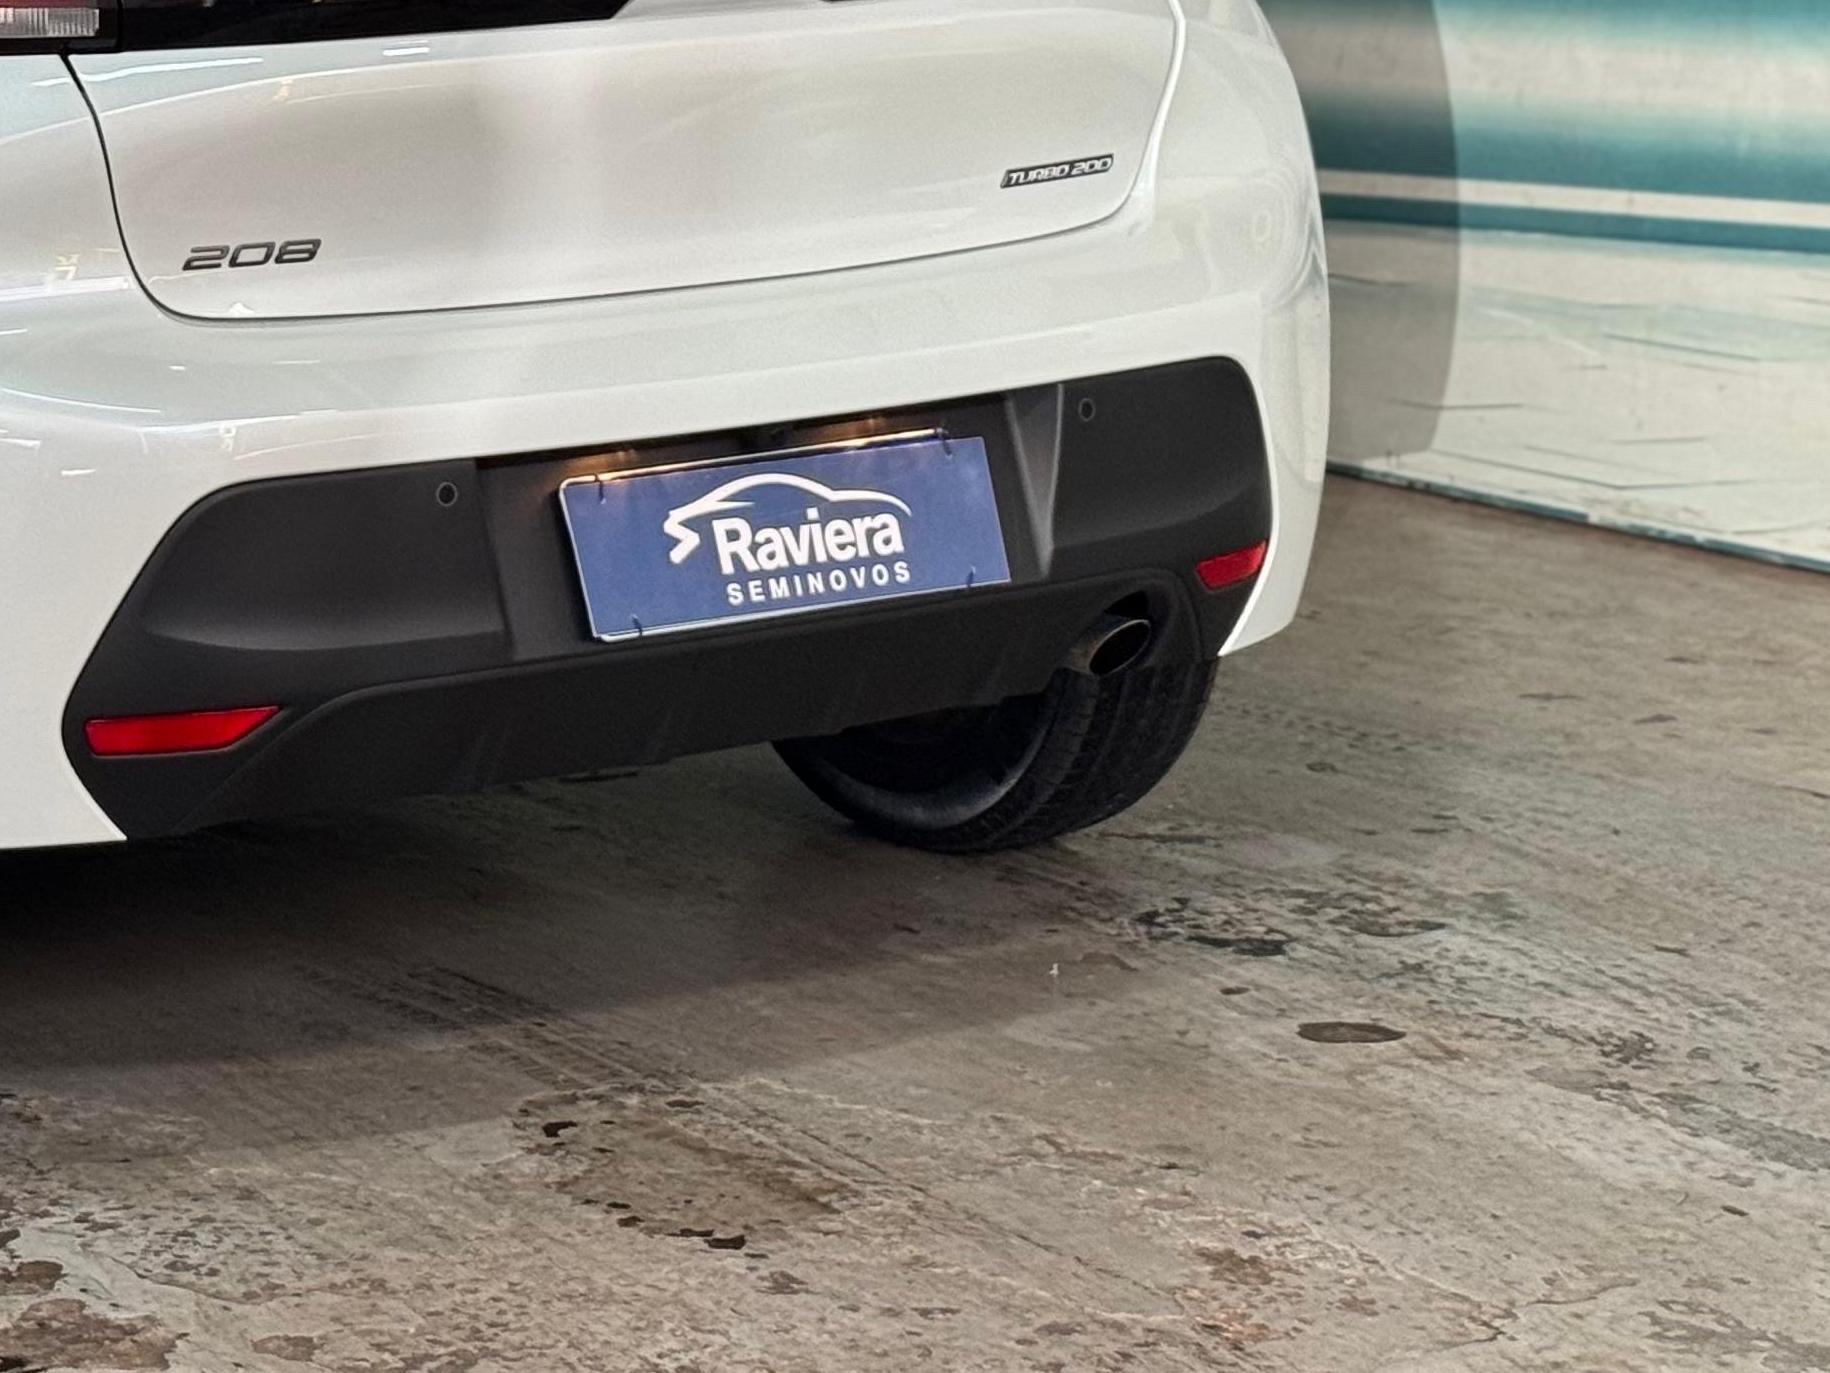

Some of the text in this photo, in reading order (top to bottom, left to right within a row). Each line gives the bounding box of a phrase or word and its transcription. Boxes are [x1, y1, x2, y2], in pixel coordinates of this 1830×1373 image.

[1009, 158, 1112, 184] TURBO 200
[182, 238, 322, 271] 208
[711, 507, 905, 575] Raviera
[726, 560, 912, 606] SEMINOVOS
